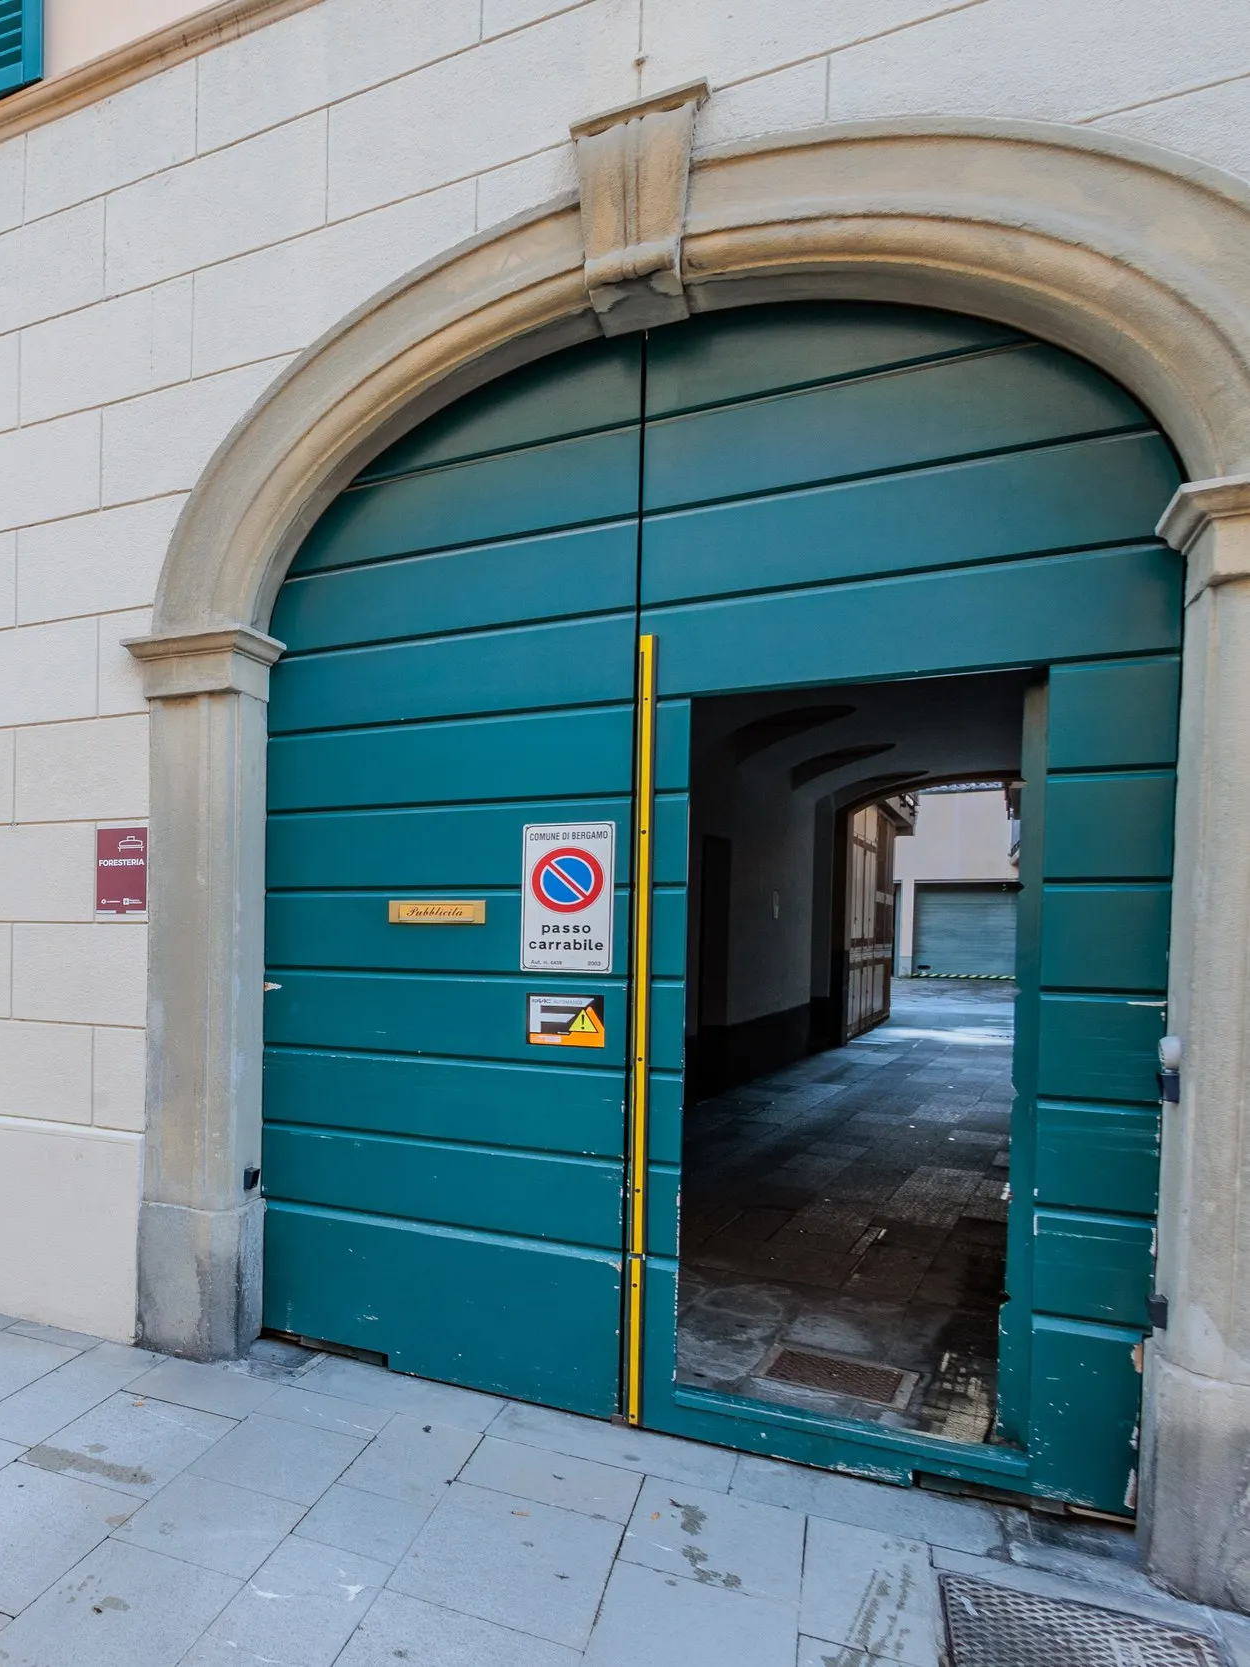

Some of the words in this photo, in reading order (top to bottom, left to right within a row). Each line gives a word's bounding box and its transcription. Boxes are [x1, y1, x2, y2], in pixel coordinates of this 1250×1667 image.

[529, 832, 560, 841] COMUNE
[562, 831, 570, 840] DI
[571, 830, 609, 840] BERGAMO
[98, 858, 145, 867] FORESTERIA
[541, 924, 592, 936] passo
[528, 939, 604, 951] carrabile
